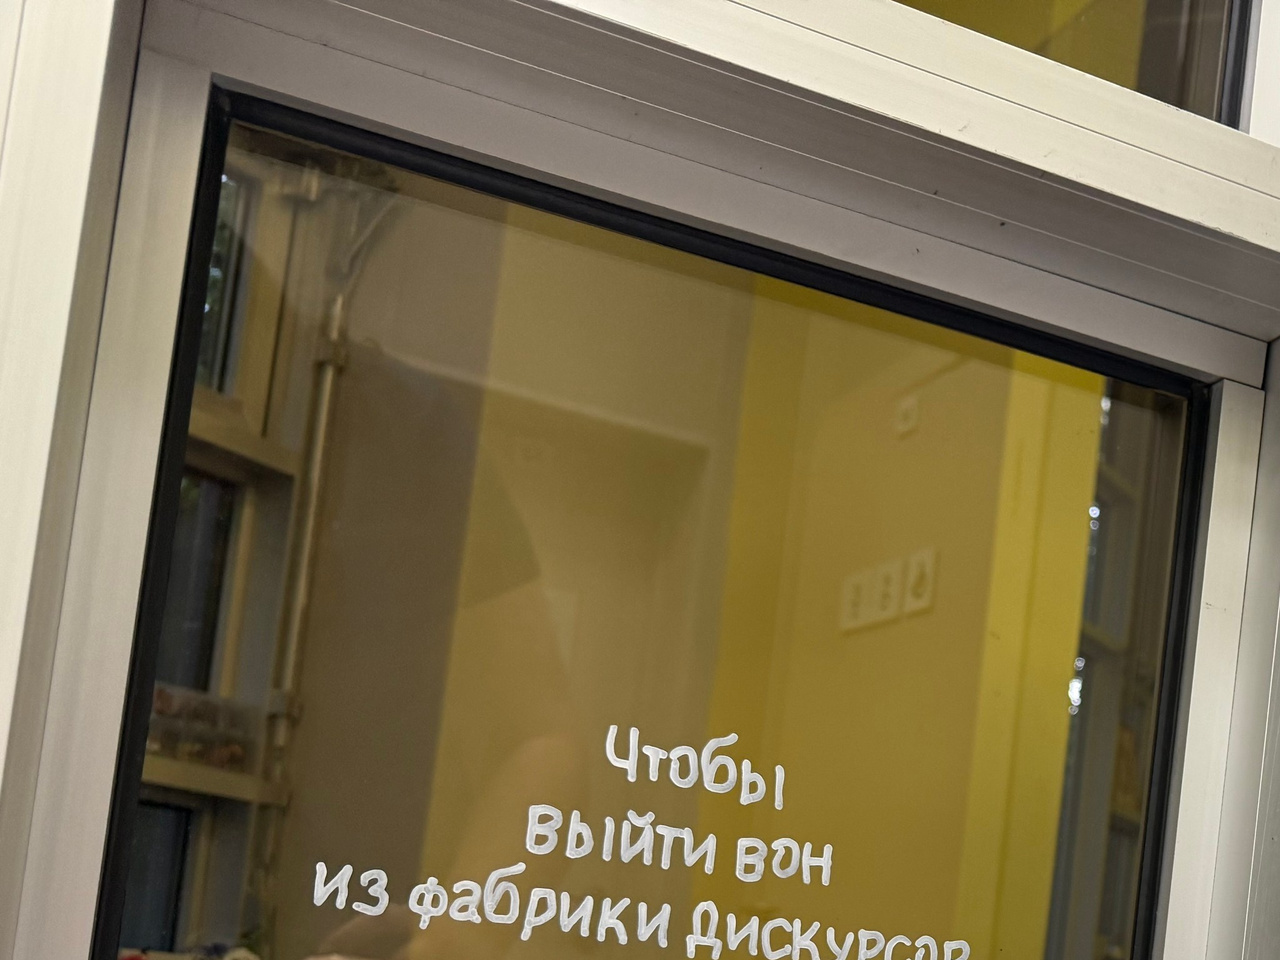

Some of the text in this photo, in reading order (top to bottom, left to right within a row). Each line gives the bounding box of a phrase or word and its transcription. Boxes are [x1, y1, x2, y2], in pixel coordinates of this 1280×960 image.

[605, 724, 785, 811] Чтобы
[525, 804, 833, 887] выйти вон
[313, 861, 390, 917] из
[408, 861, 672, 949] фабрики
